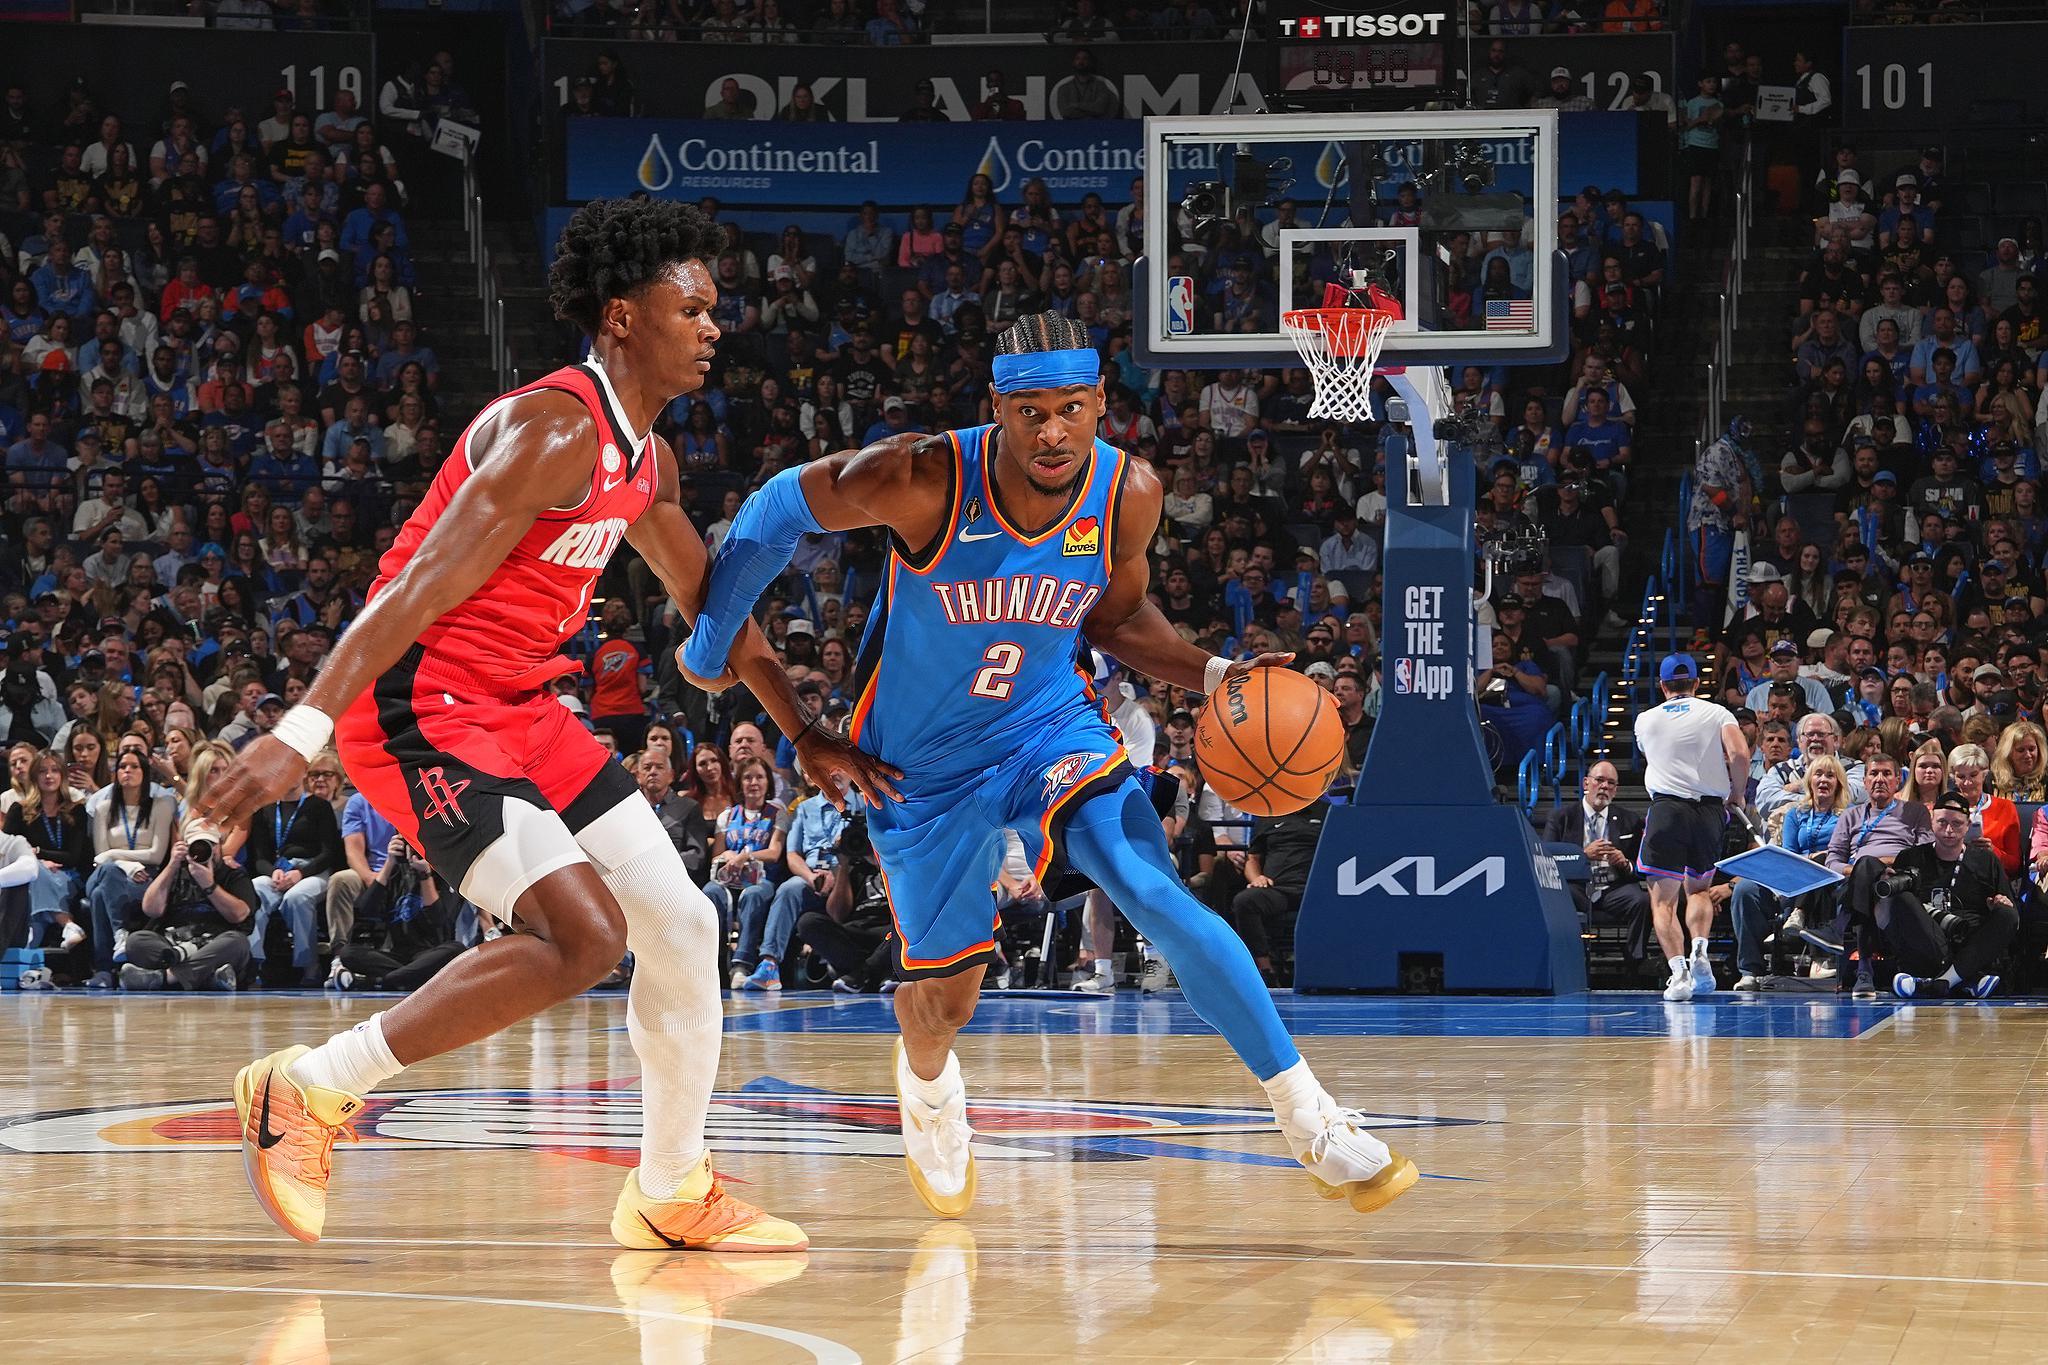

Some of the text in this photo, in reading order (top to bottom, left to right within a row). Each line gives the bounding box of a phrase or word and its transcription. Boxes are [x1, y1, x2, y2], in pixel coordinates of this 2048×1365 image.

[1324, 13, 1446, 38] TISSOT
[281, 65, 361, 110] 119
[1856, 62, 1932, 109] 101
[679, 138, 880, 173] Continental
[681, 176, 771, 189] RESOURCES
[1019, 176, 1109, 188] ROURCES
[931, 574, 1101, 628] THUNDER
[1405, 586, 1444, 619] GET
[1404, 622, 1444, 655] THE
[969, 641, 1025, 702] 2
[1413, 659, 1453, 700] App
